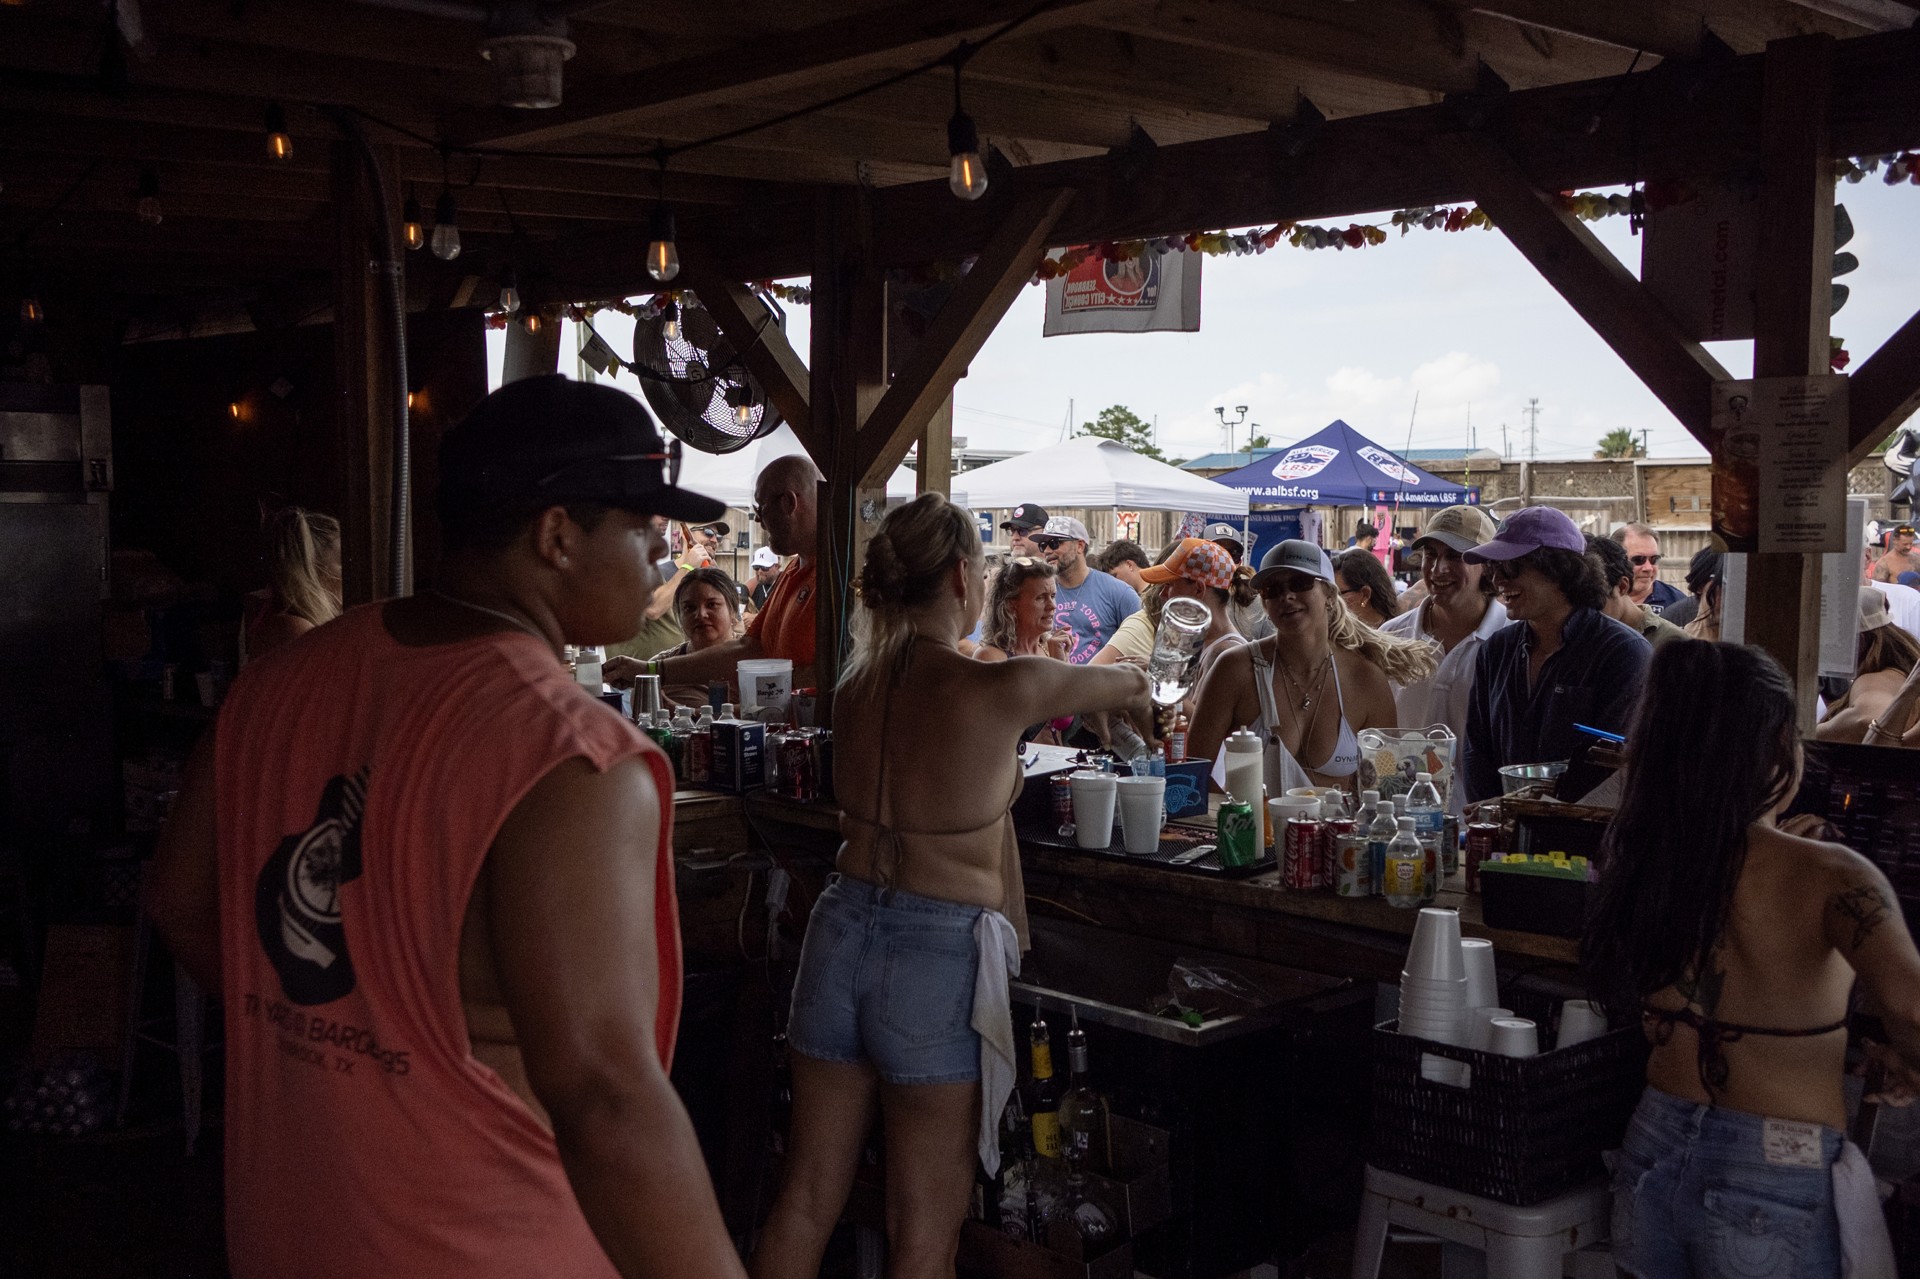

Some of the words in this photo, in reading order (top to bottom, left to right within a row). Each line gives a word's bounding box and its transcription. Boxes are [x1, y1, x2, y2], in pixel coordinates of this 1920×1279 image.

[1282, 463, 1319, 472] LBSF
[1405, 491, 1440, 503] American
[1439, 492, 1457, 503] LBSF
[1057, 601, 1078, 612] ORT
[1080, 603, 1102, 629] YOUR
[1070, 640, 1102, 665] OOKER
